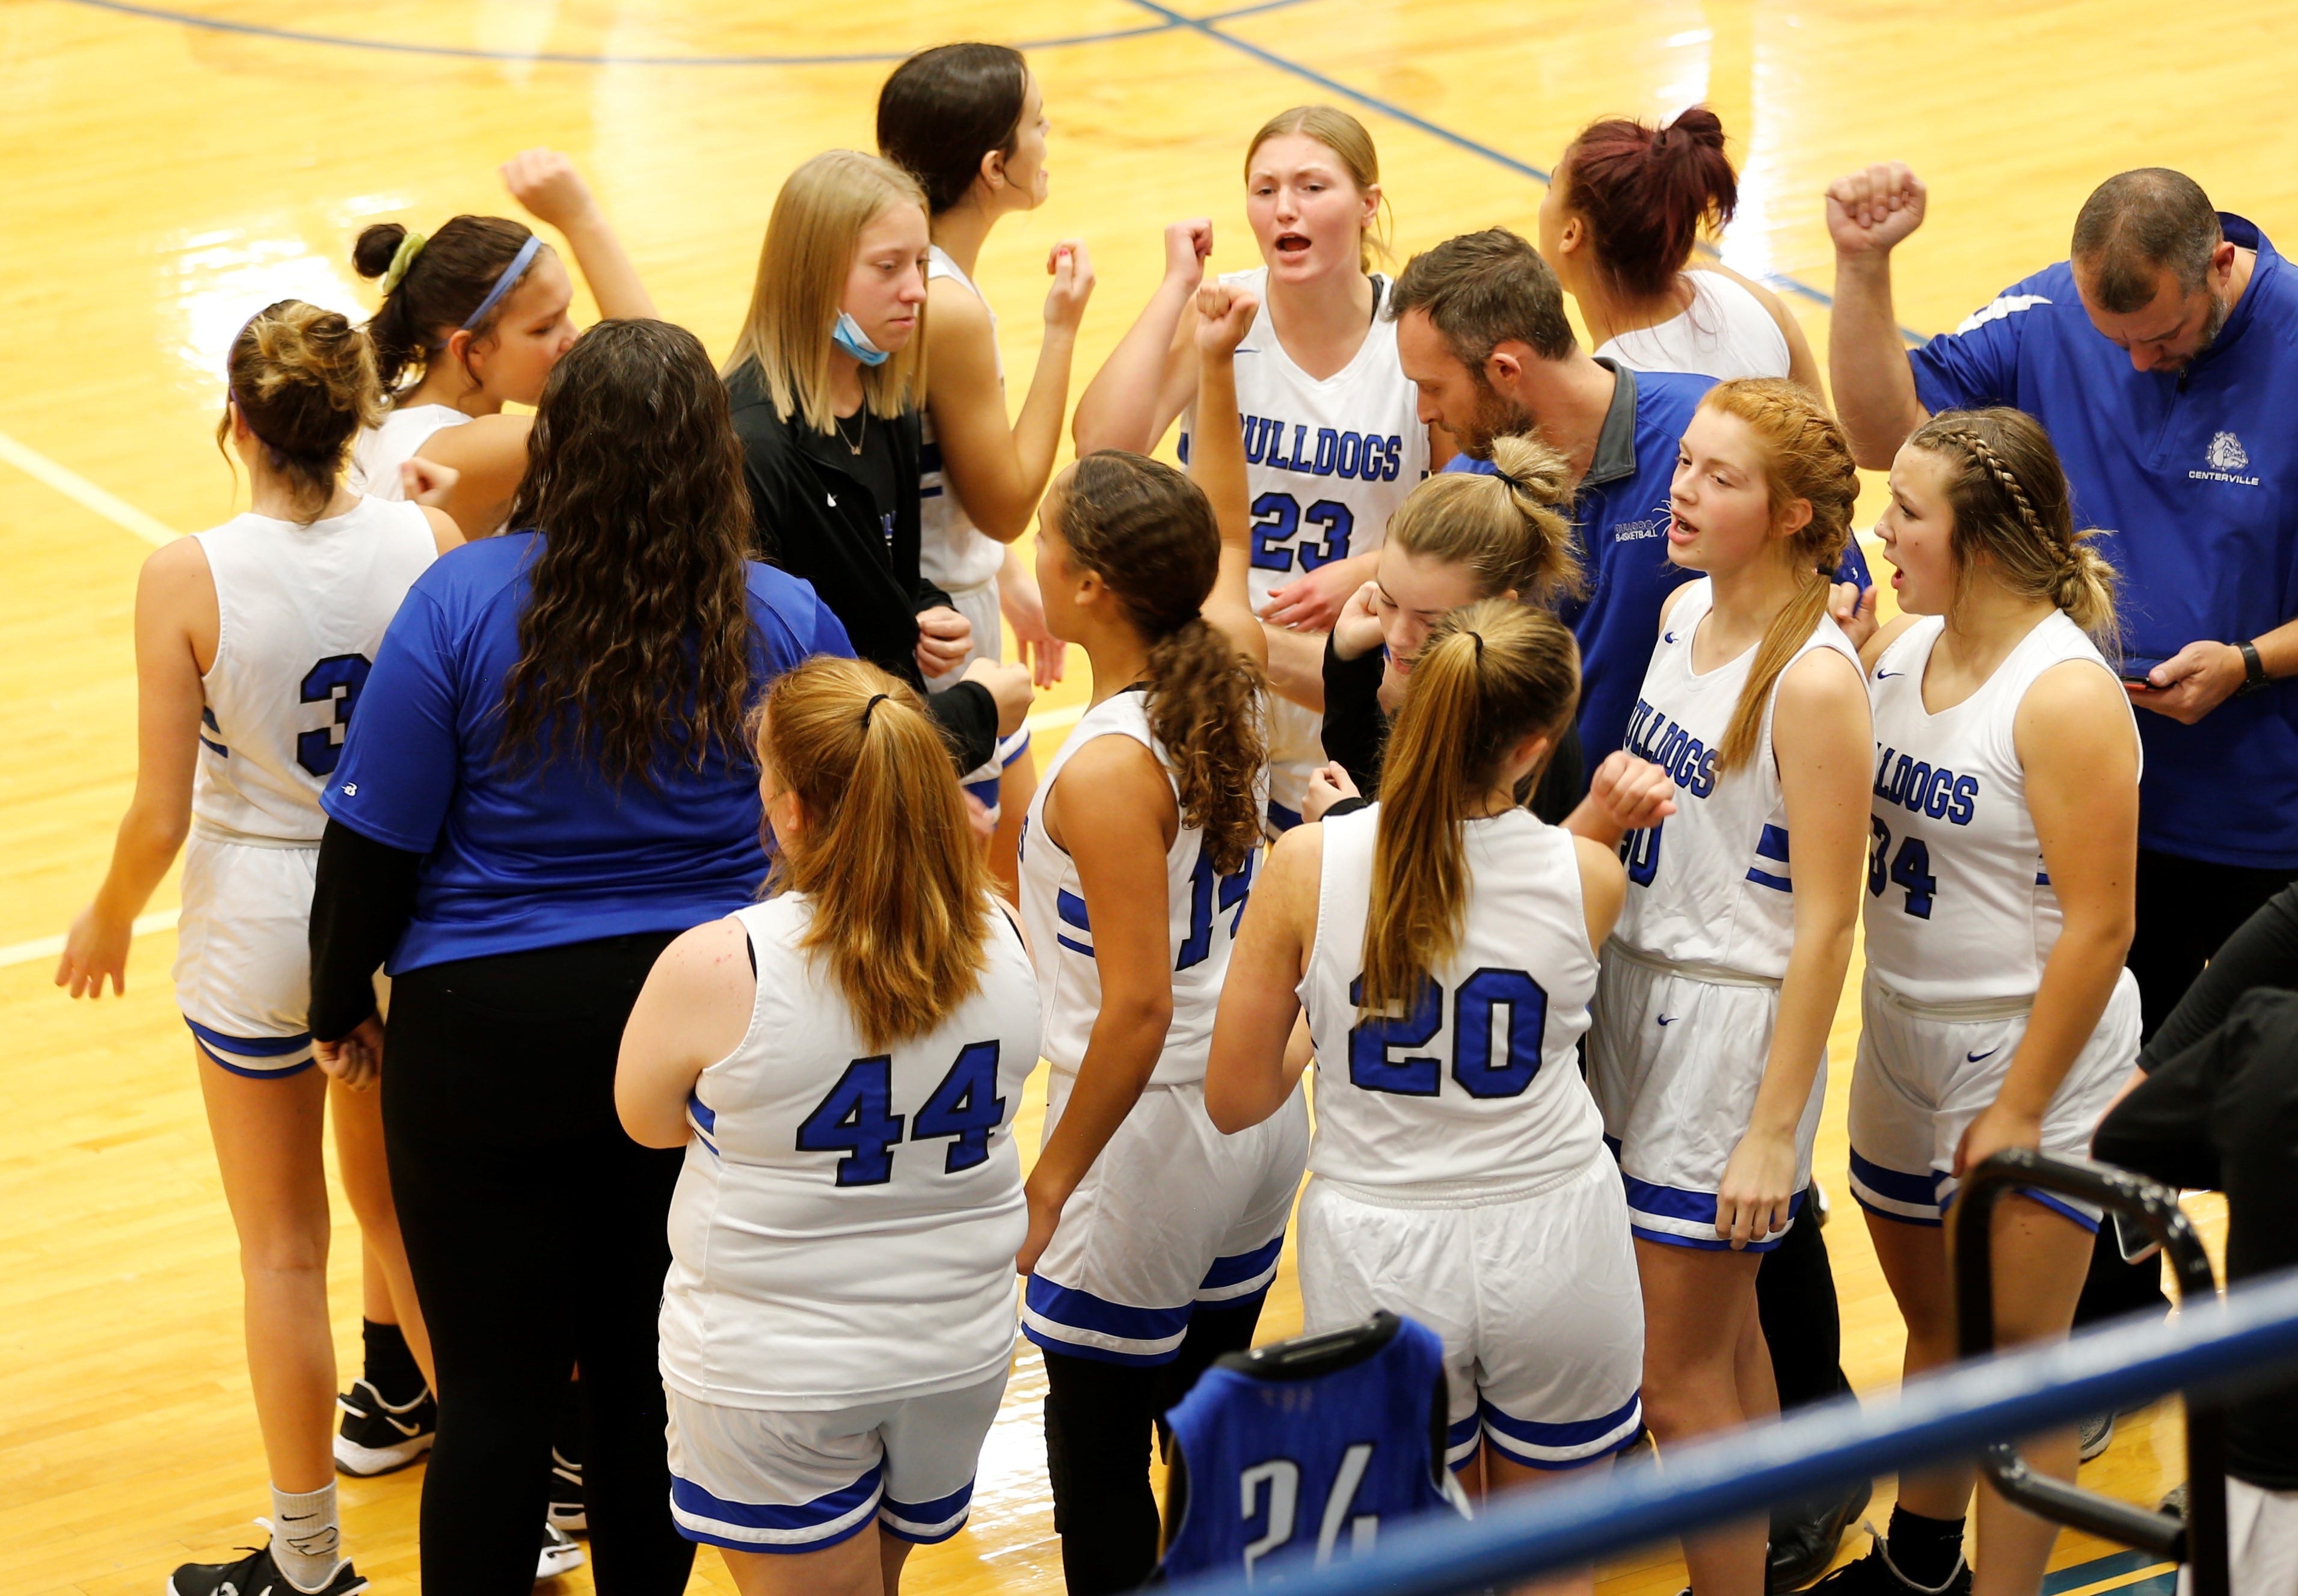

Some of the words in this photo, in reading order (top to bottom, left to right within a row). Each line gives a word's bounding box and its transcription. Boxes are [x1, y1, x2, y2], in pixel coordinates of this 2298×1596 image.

[2189, 470, 2260, 486] CENTERVILLE
[1251, 491, 1354, 573] 23
[1615, 529, 1658, 542] BASKETBALL
[1624, 698, 1724, 799] ULLDOGS
[1873, 741, 1979, 826] LDOGS
[1348, 966, 1548, 1099] 20
[795, 1039, 1007, 1188] 44
